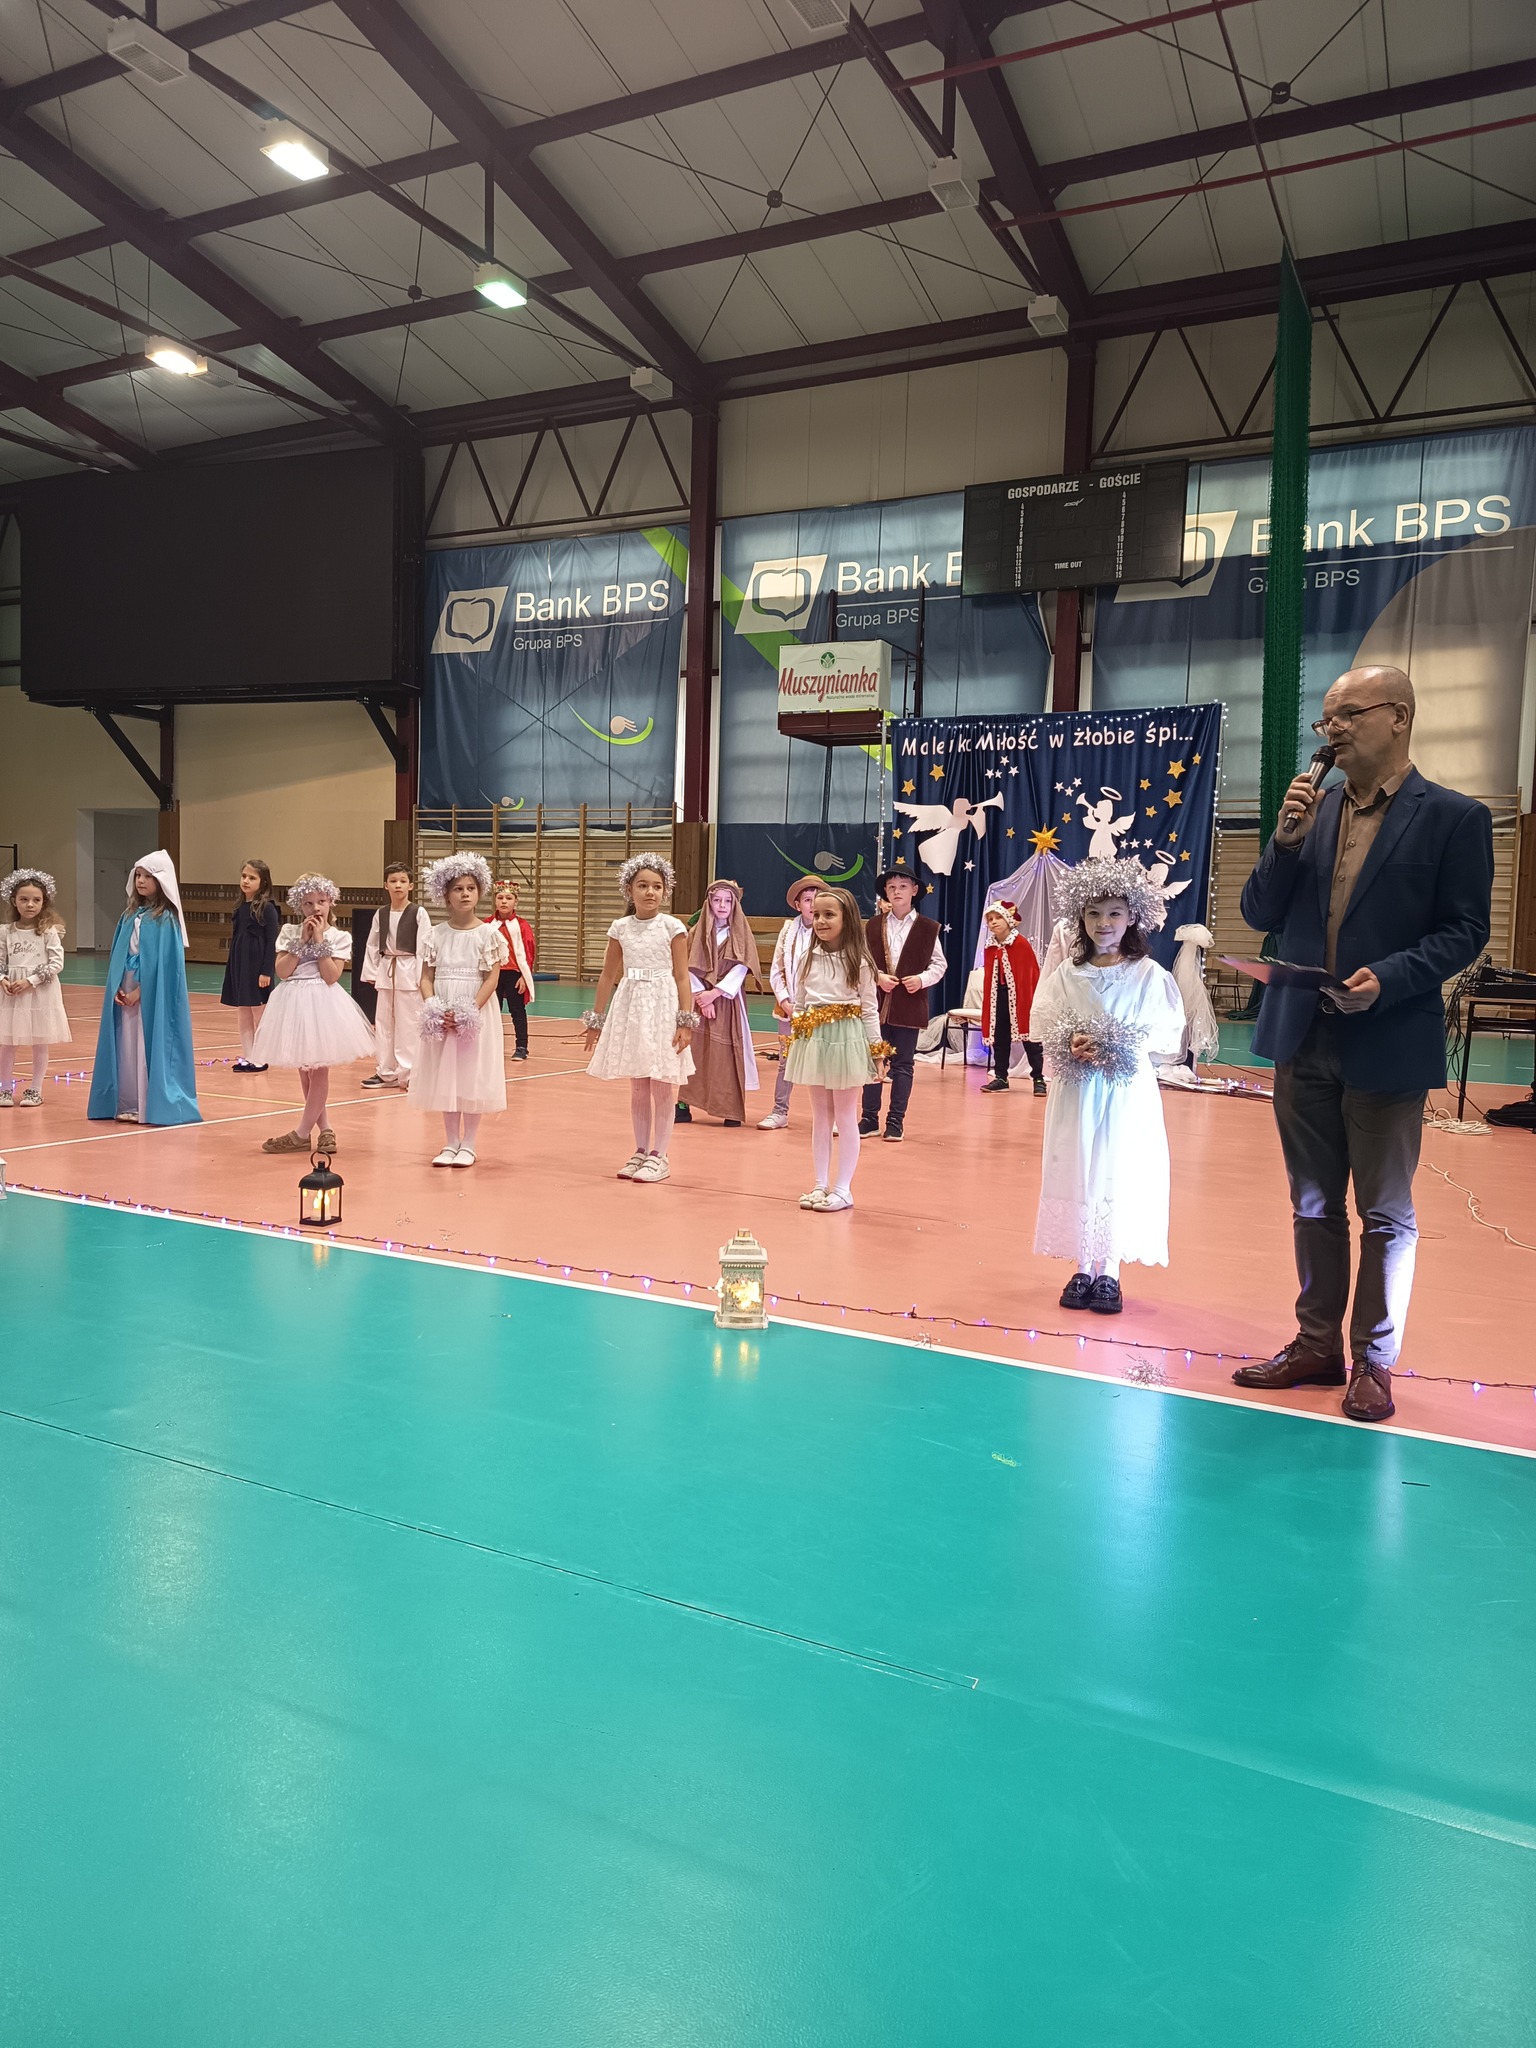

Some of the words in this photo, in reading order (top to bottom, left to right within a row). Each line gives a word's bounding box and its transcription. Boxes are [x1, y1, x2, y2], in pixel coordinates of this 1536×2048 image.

[1007, 480, 1080, 499] GOSPODARZE
[1099, 473, 1141, 489] GOŚCIE
[1394, 495, 1511, 545] BPS
[837, 554, 932, 596] Bank
[1054, 562, 1069, 570] TIME
[1070, 561, 1082, 569] OUT
[1115, 571, 1122, 579] 15
[1314, 569, 1360, 589] BPS
[515, 587, 592, 622] Bank
[602, 579, 670, 617] BPS
[835, 612, 881, 630] Grupa
[886, 607, 920, 625] BPS
[513, 636, 552, 652] Grupa
[556, 634, 583, 649] BPS
[778, 665, 878, 703] Muszynianka
[975, 728, 1039, 751] Miłość
[1049, 733, 1064, 749] w
[1073, 726, 1136, 747] żłobie
[1145, 721, 1194, 747] śpi...
